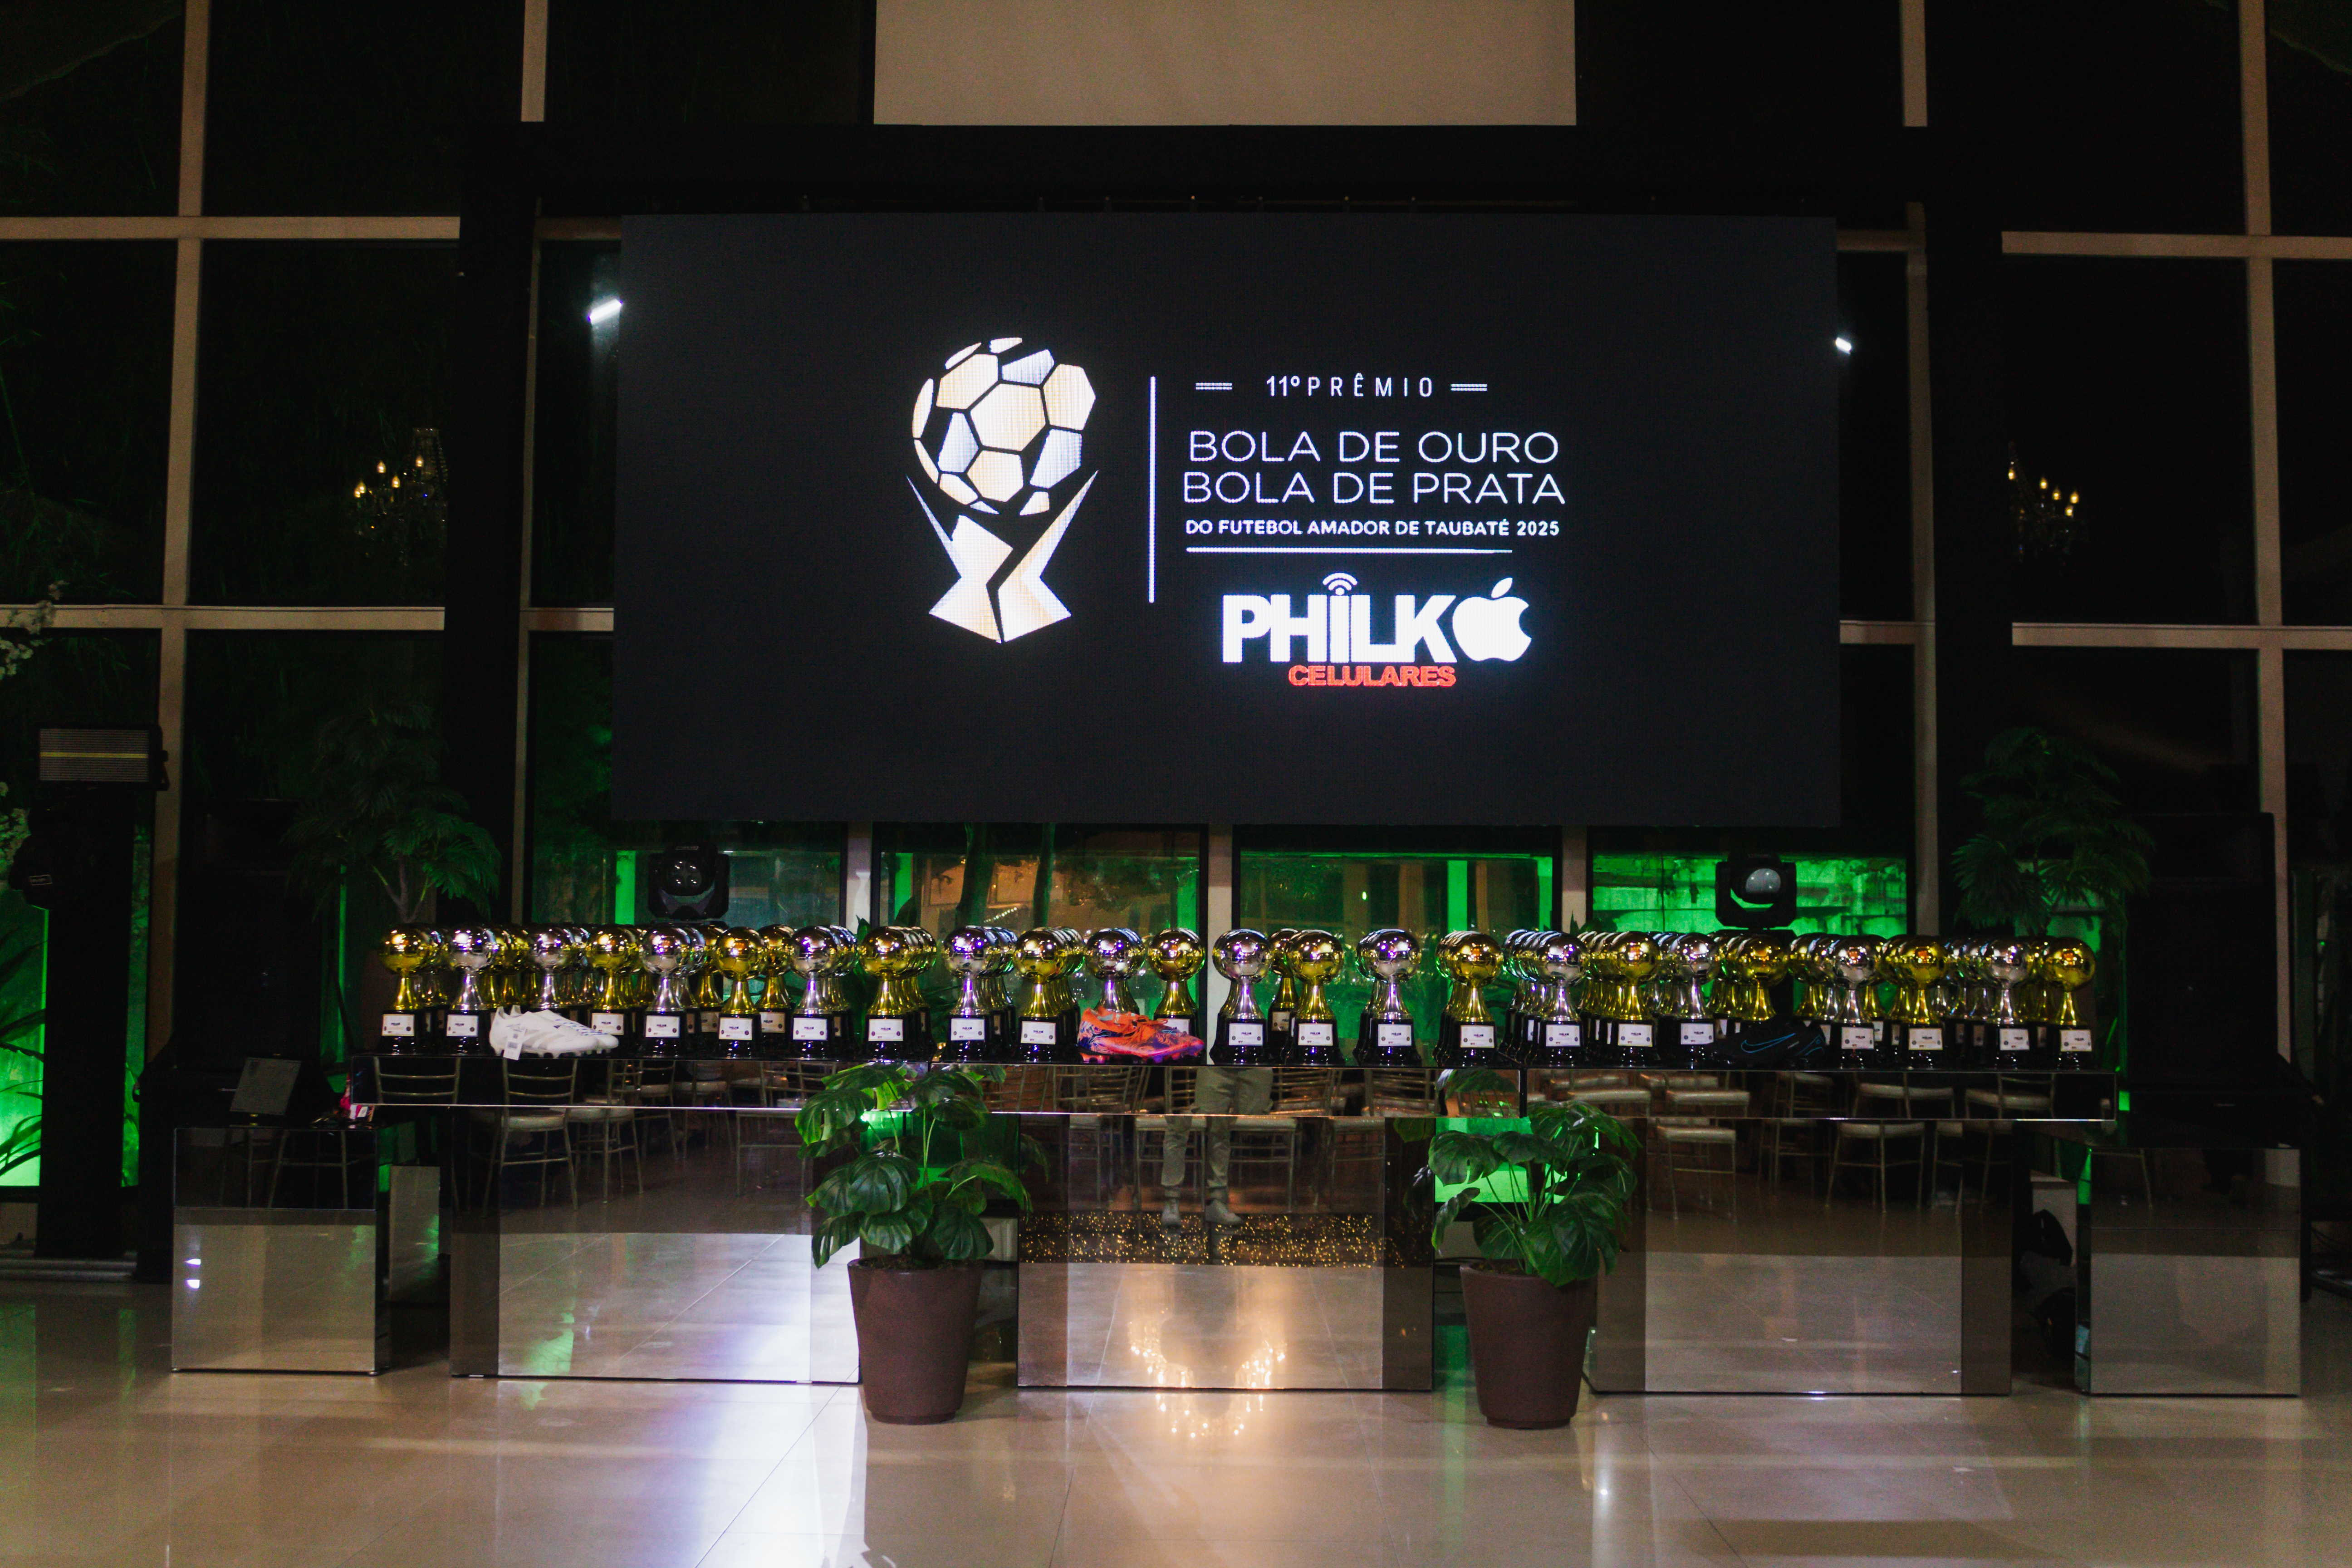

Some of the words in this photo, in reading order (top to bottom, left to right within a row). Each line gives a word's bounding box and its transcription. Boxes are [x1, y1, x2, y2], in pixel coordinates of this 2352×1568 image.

[1308, 373, 1433, 397] PRÊMIO
[1190, 431, 1321, 462] BOLA
[1339, 431, 1401, 463] DE
[1418, 431, 1559, 464] OURO
[1183, 471, 1315, 504] BOLA
[1333, 472, 1395, 504] DE
[1413, 473, 1566, 505] PRATA
[1185, 519, 1213, 535] DO
[1218, 519, 1303, 535] FUTEBOL
[1307, 520, 1390, 535] AMADOR
[1395, 520, 1420, 535] DE
[1424, 519, 1509, 536] TAUBATÉ
[1516, 520, 1560, 536] 2025
[1288, 665, 1457, 687] CELULARES
